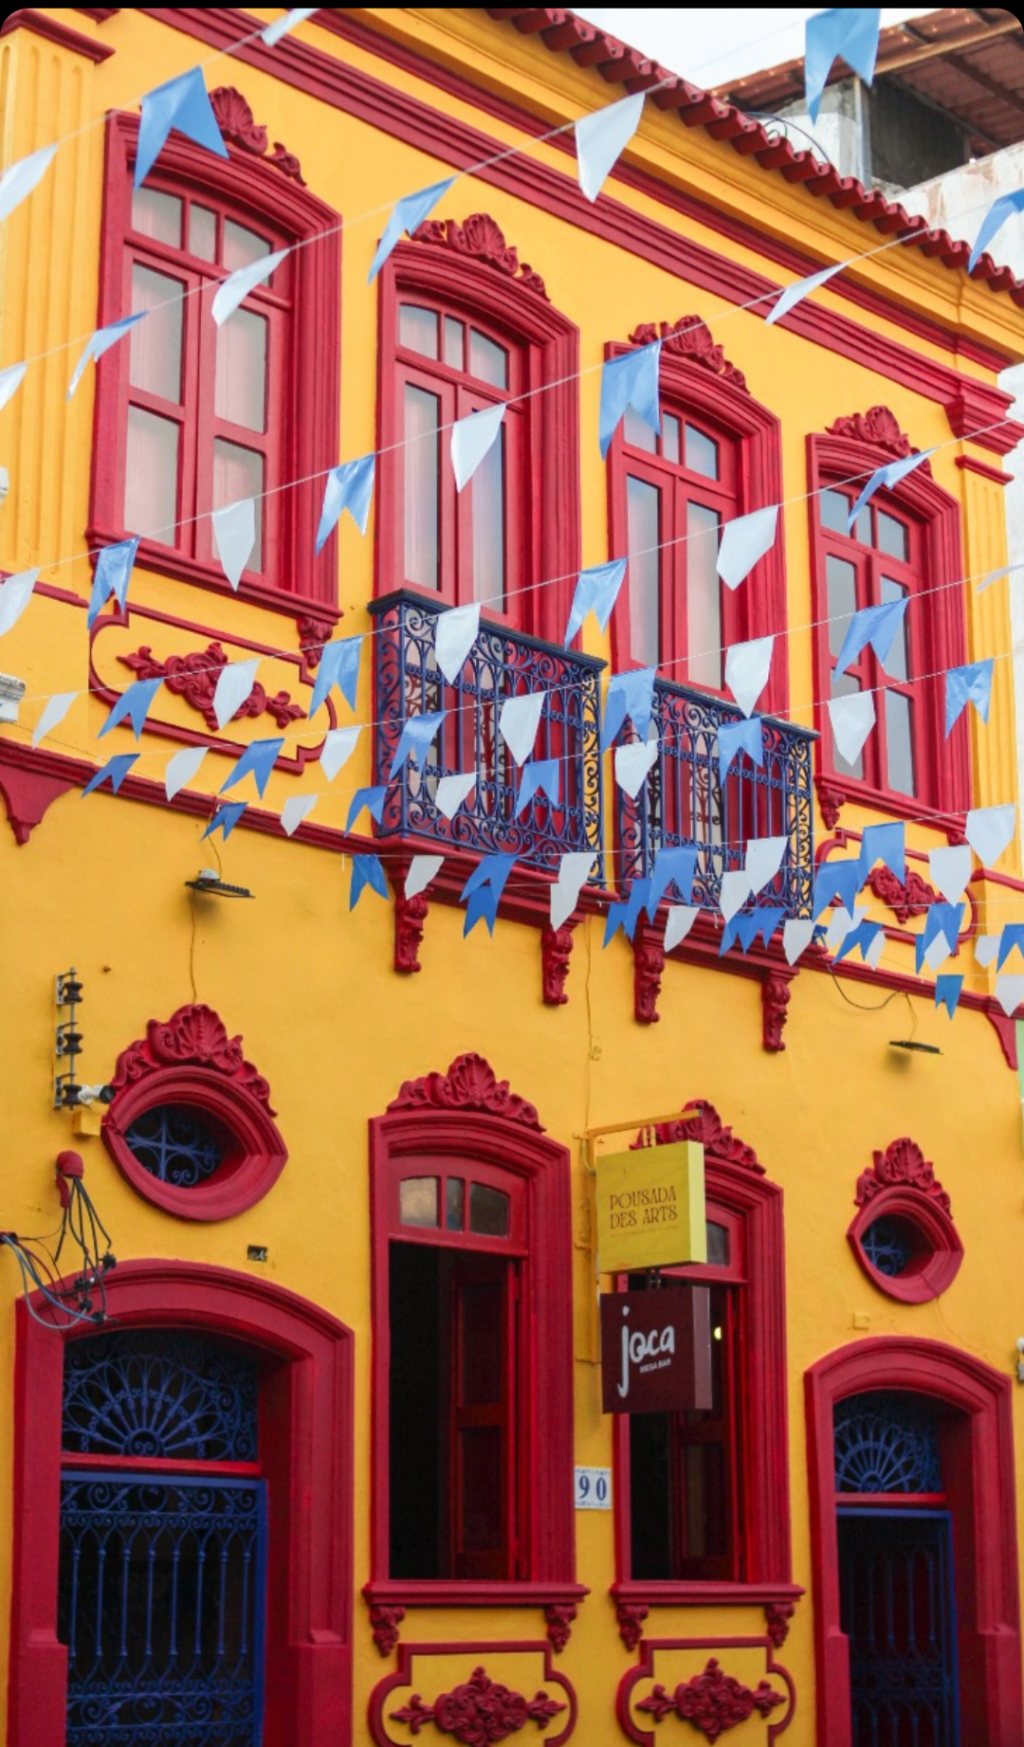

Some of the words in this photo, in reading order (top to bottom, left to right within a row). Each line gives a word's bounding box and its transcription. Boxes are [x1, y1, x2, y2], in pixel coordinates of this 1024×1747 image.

[609, 1185, 677, 1211] POUSADA
[610, 1210, 637, 1229] DES
[643, 1204, 678, 1225] ARTS
[617, 1305, 675, 1398] joca
[658, 1358, 672, 1369] BAR
[578, 1474, 607, 1501] 90
